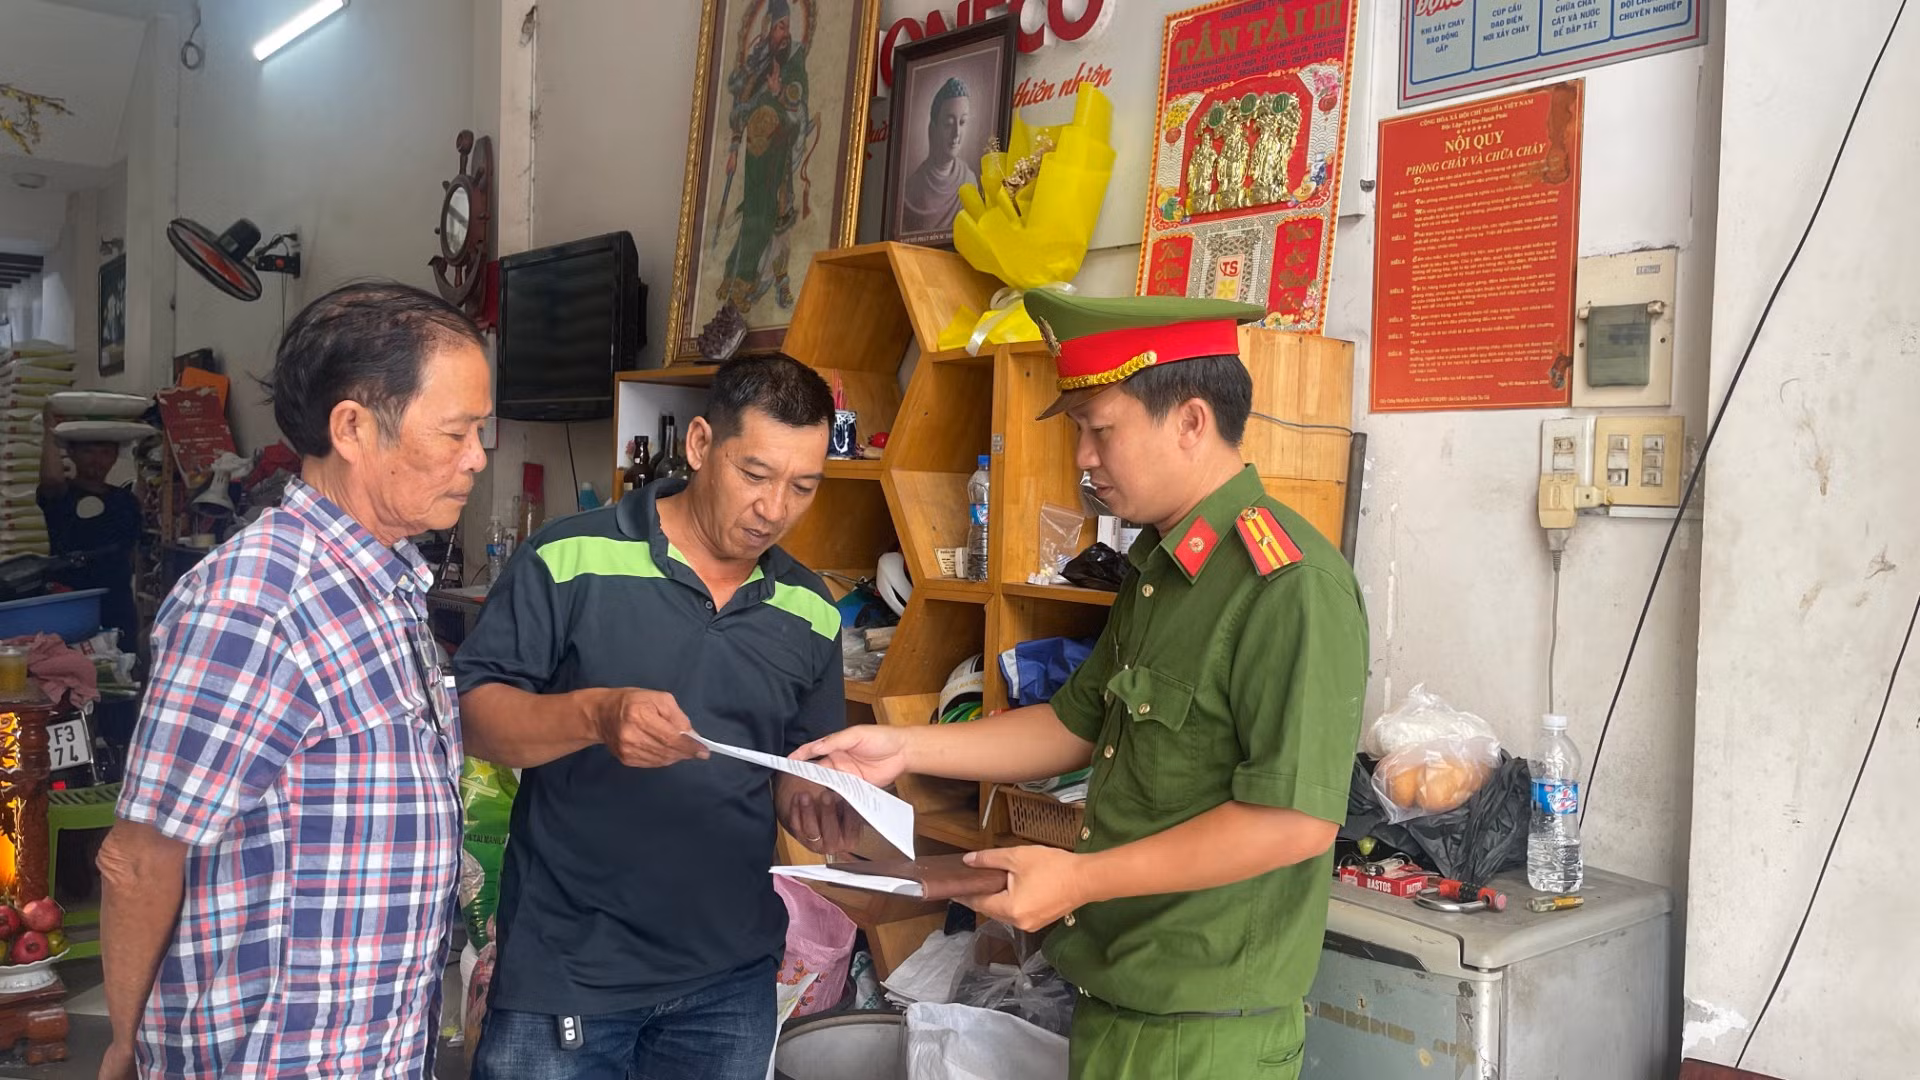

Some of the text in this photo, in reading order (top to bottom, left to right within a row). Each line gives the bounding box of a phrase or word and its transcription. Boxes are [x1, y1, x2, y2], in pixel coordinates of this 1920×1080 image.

[1014, 77, 1055, 109] thiên
[1444, 130, 1505, 154] NỘI QUY
[1405, 142, 1547, 176] PHÒNG CHÁY VÀ CHỮA CHÁY
[1221, 259, 1239, 276] TS
[54, 725, 75, 745] F3
